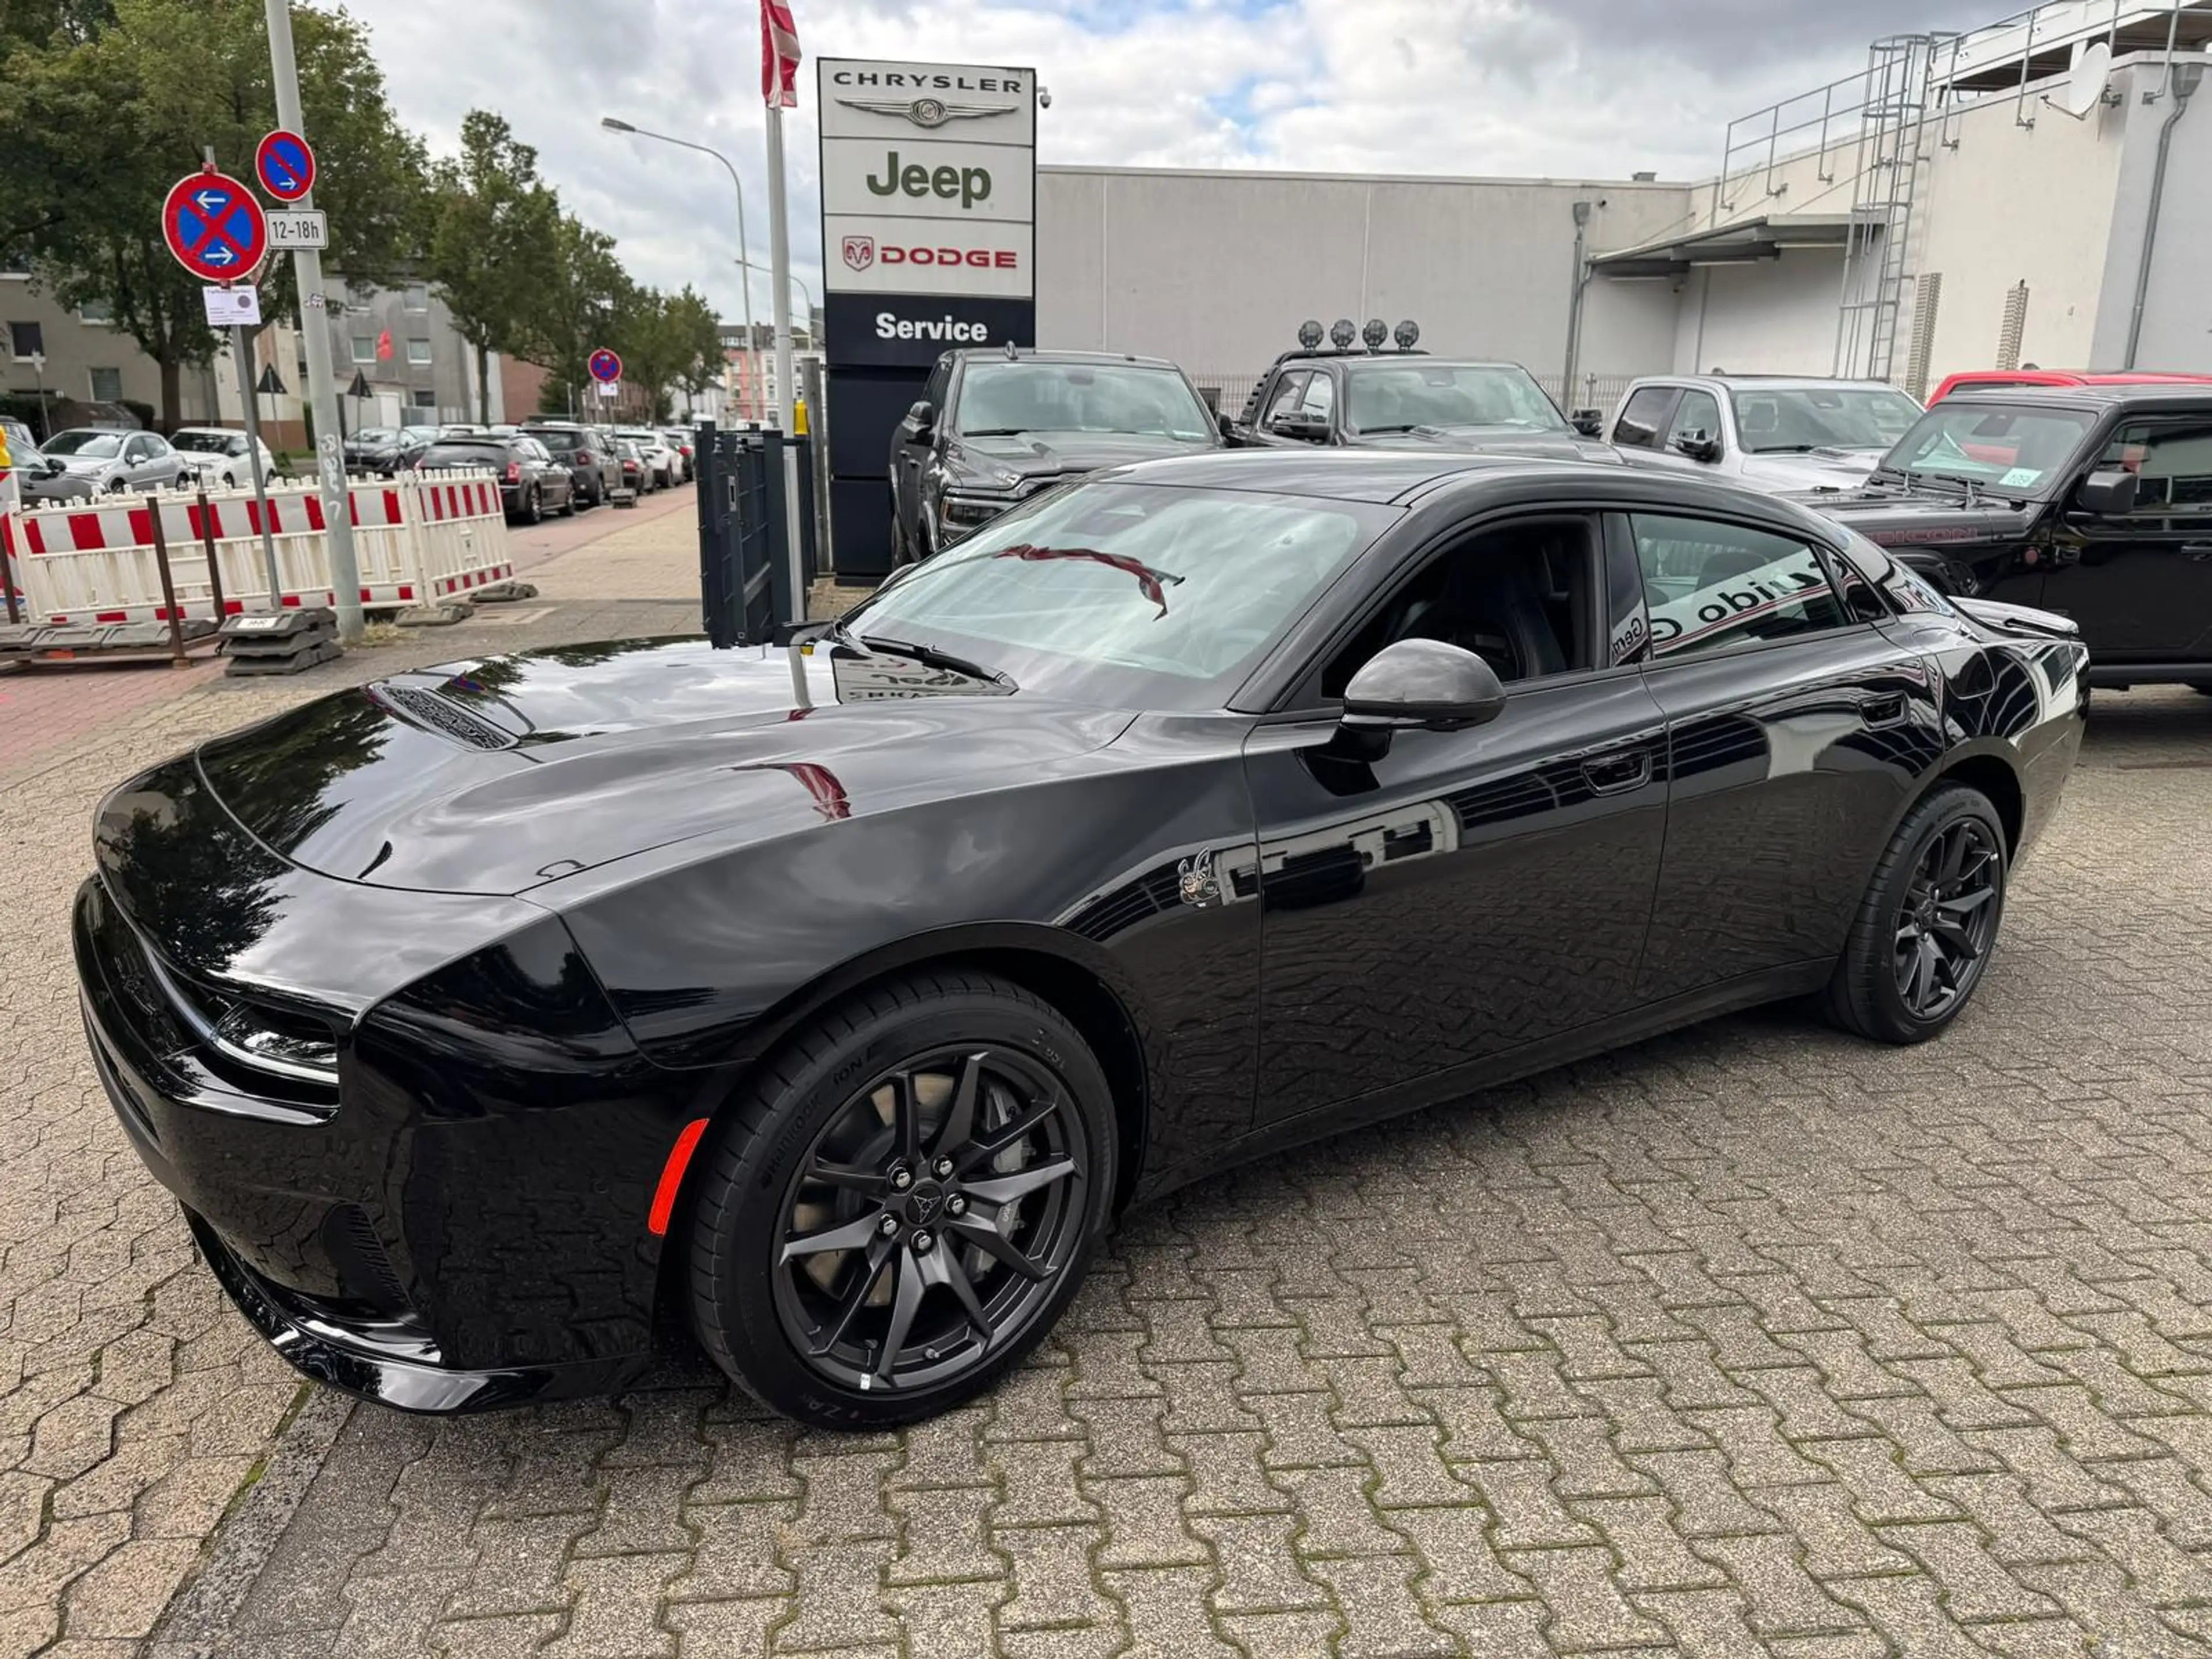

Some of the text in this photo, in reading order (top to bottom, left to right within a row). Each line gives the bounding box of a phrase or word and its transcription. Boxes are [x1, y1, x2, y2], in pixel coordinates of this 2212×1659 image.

[834, 72, 1022, 93] CHRYSLER
[867, 151, 991, 209] Jeep
[272, 221, 319, 238] 12-18h
[881, 247, 1017, 268] DODGE
[876, 313, 988, 342] Service
